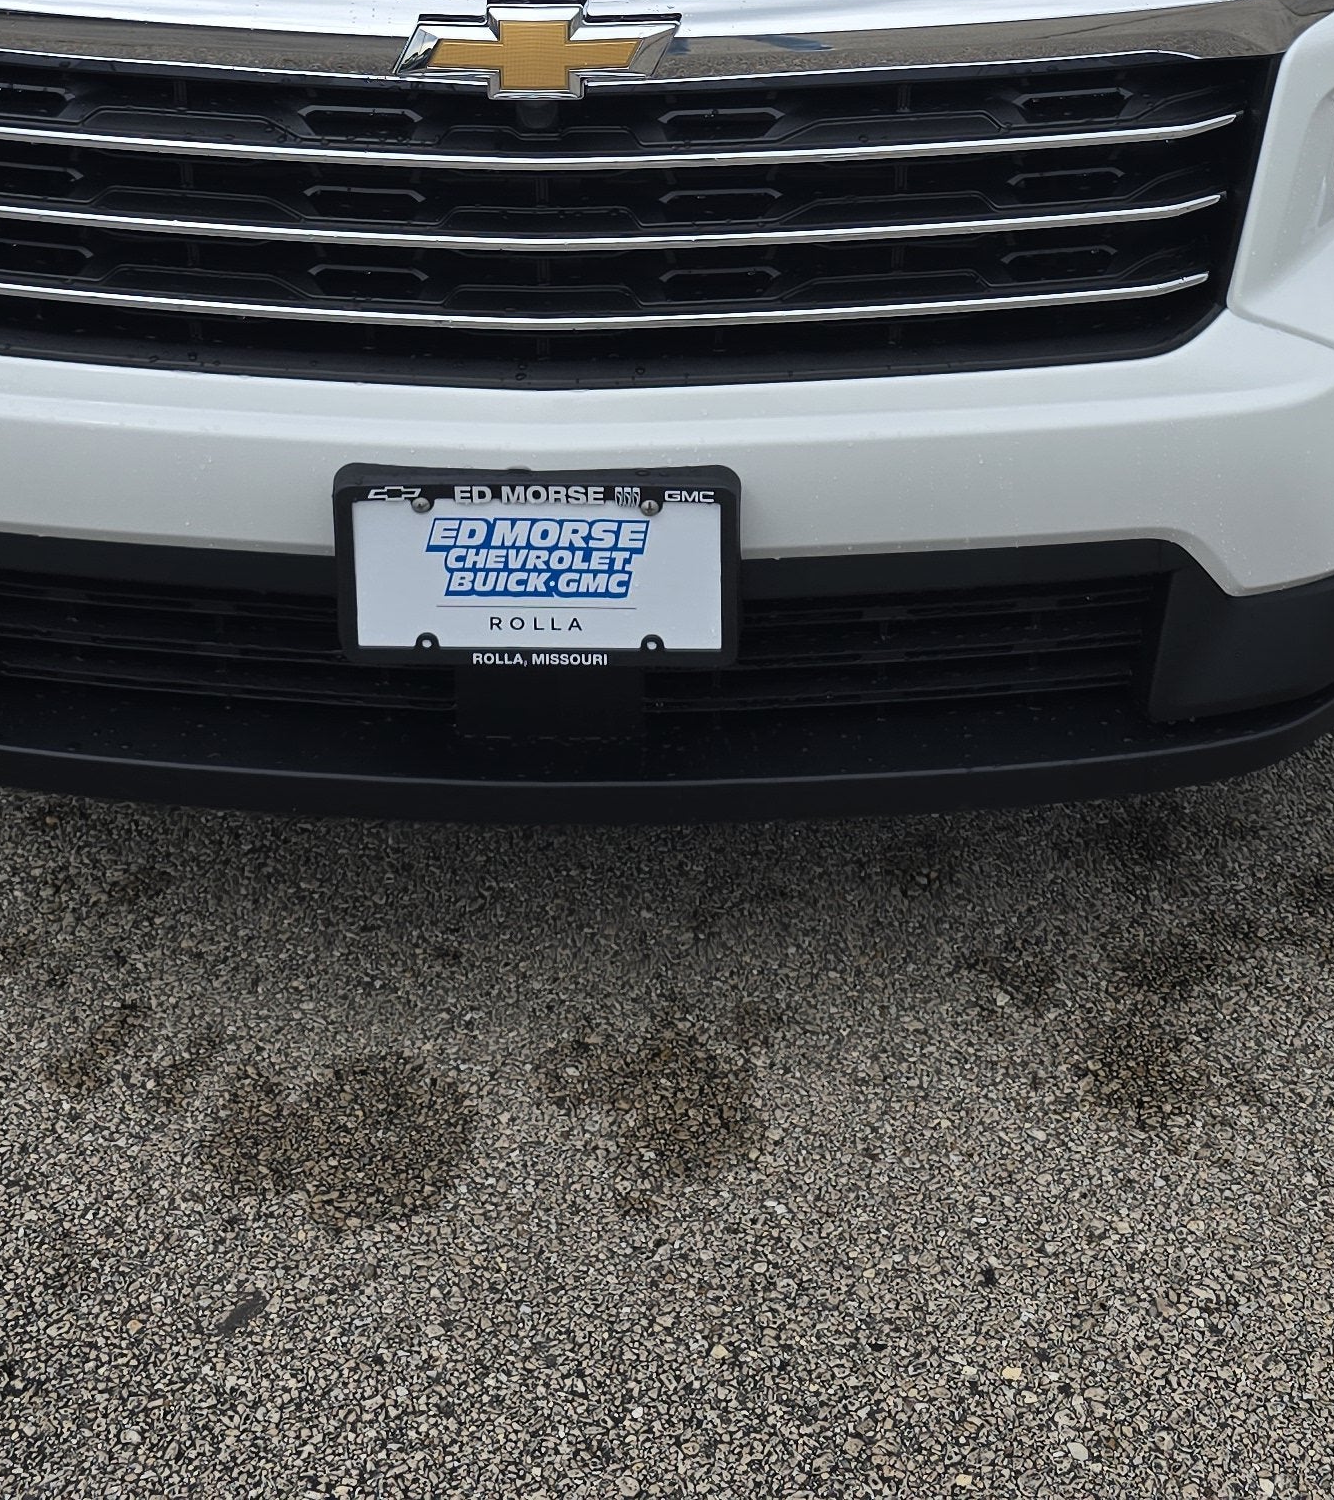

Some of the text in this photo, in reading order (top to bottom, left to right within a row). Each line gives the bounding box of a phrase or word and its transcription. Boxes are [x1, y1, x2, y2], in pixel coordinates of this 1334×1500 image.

[454, 486, 605, 505] ED MORSE
[664, 490, 715, 503] GMC
[429, 519, 648, 548] ED MORSE
[446, 547, 631, 570] CHEVROLET
[489, 616, 583, 631] ROLLA
[472, 652, 608, 667] ROLLA, MISSOURI
